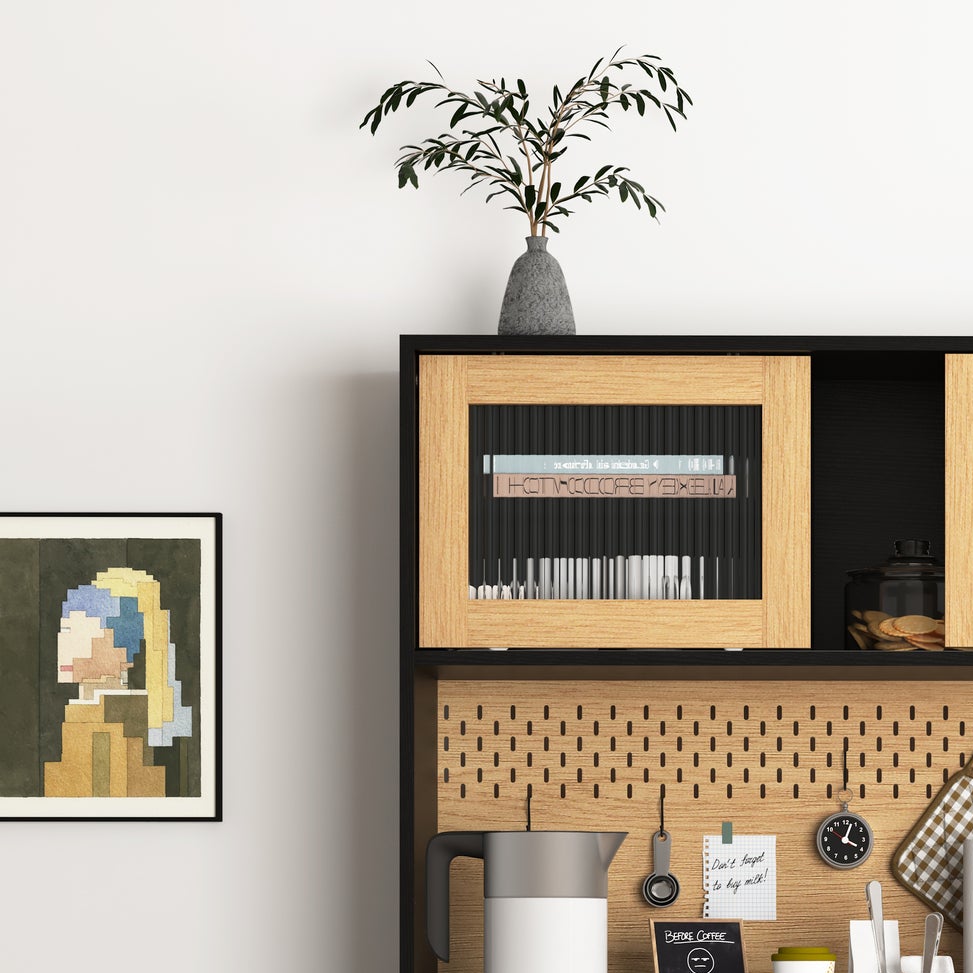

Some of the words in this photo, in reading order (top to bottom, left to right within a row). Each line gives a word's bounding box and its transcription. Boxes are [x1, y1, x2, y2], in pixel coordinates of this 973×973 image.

[712, 858, 736, 870] Don't
[740, 852, 765, 868] forget
[712, 880, 721, 890] to
[727, 878, 741, 894] buy
